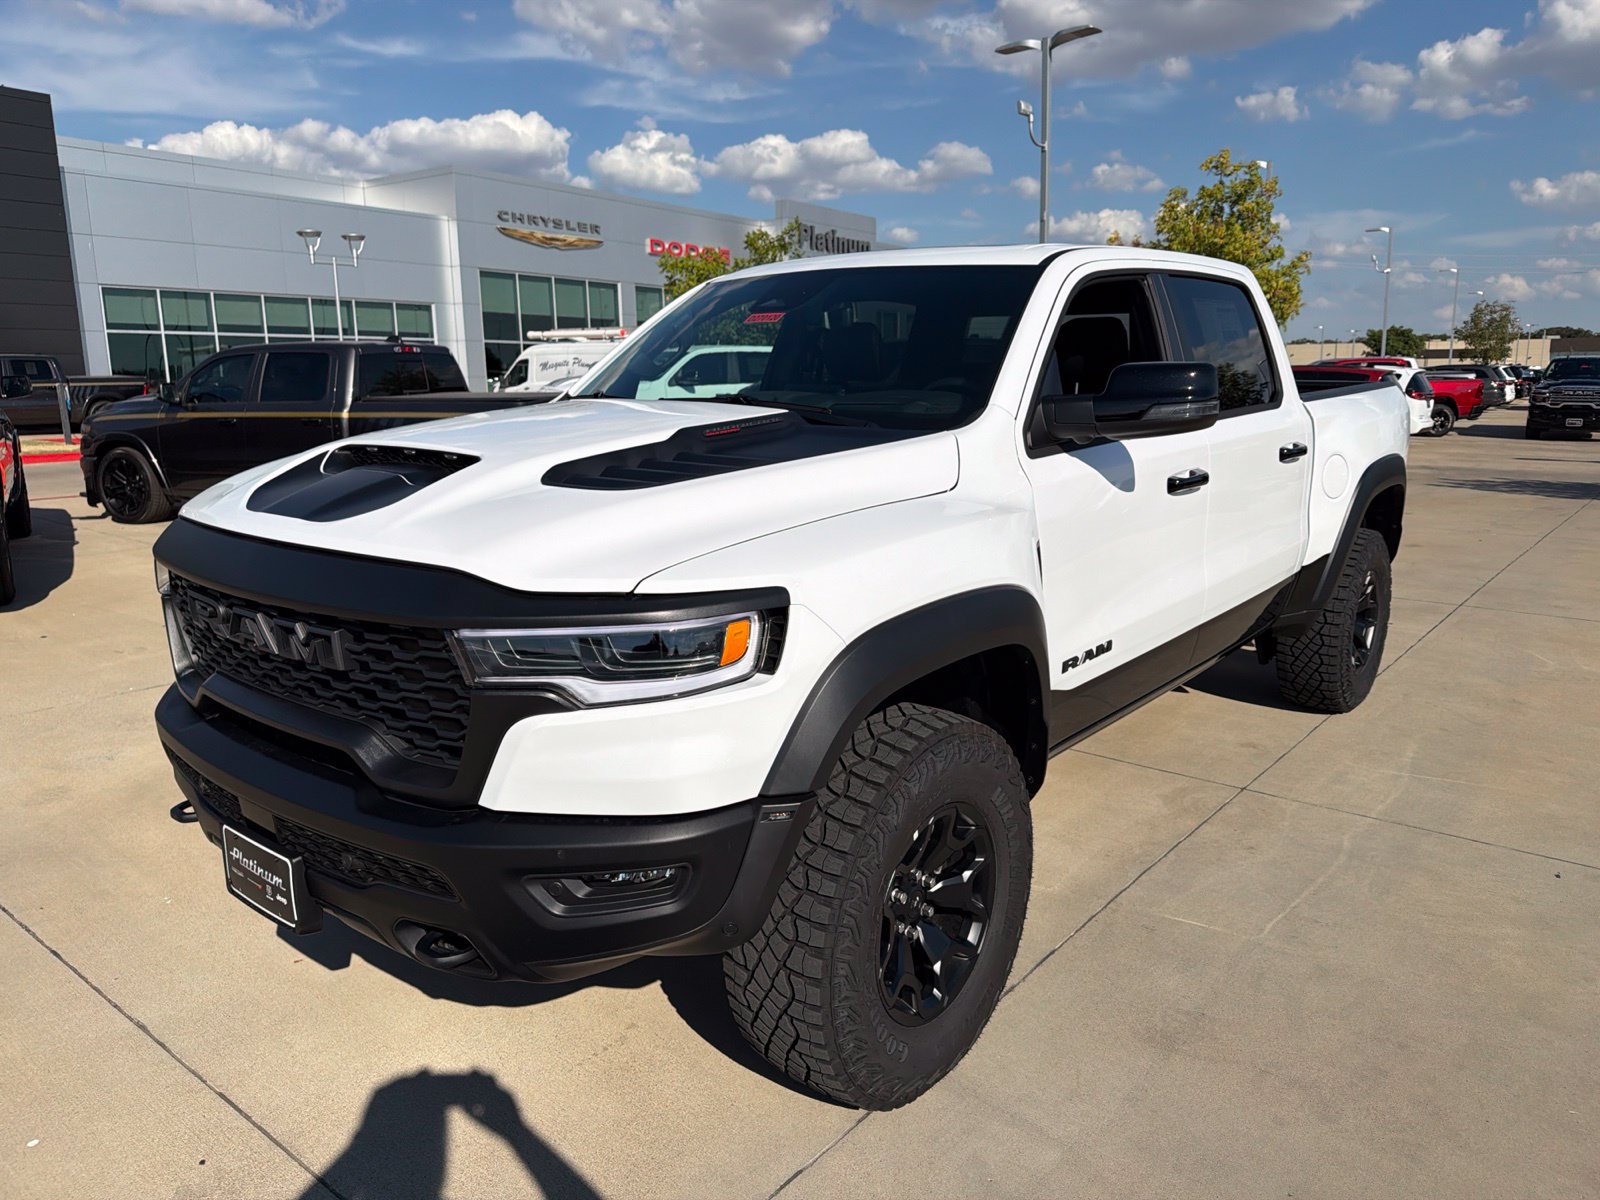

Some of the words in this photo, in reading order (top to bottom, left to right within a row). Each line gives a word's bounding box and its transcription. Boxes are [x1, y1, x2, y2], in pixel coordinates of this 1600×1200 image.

[497, 209, 601, 235] CHRYSLER
[188, 590, 354, 672] RAM
[1061, 639, 1113, 675] RAM
[229, 847, 287, 892] Platinum
